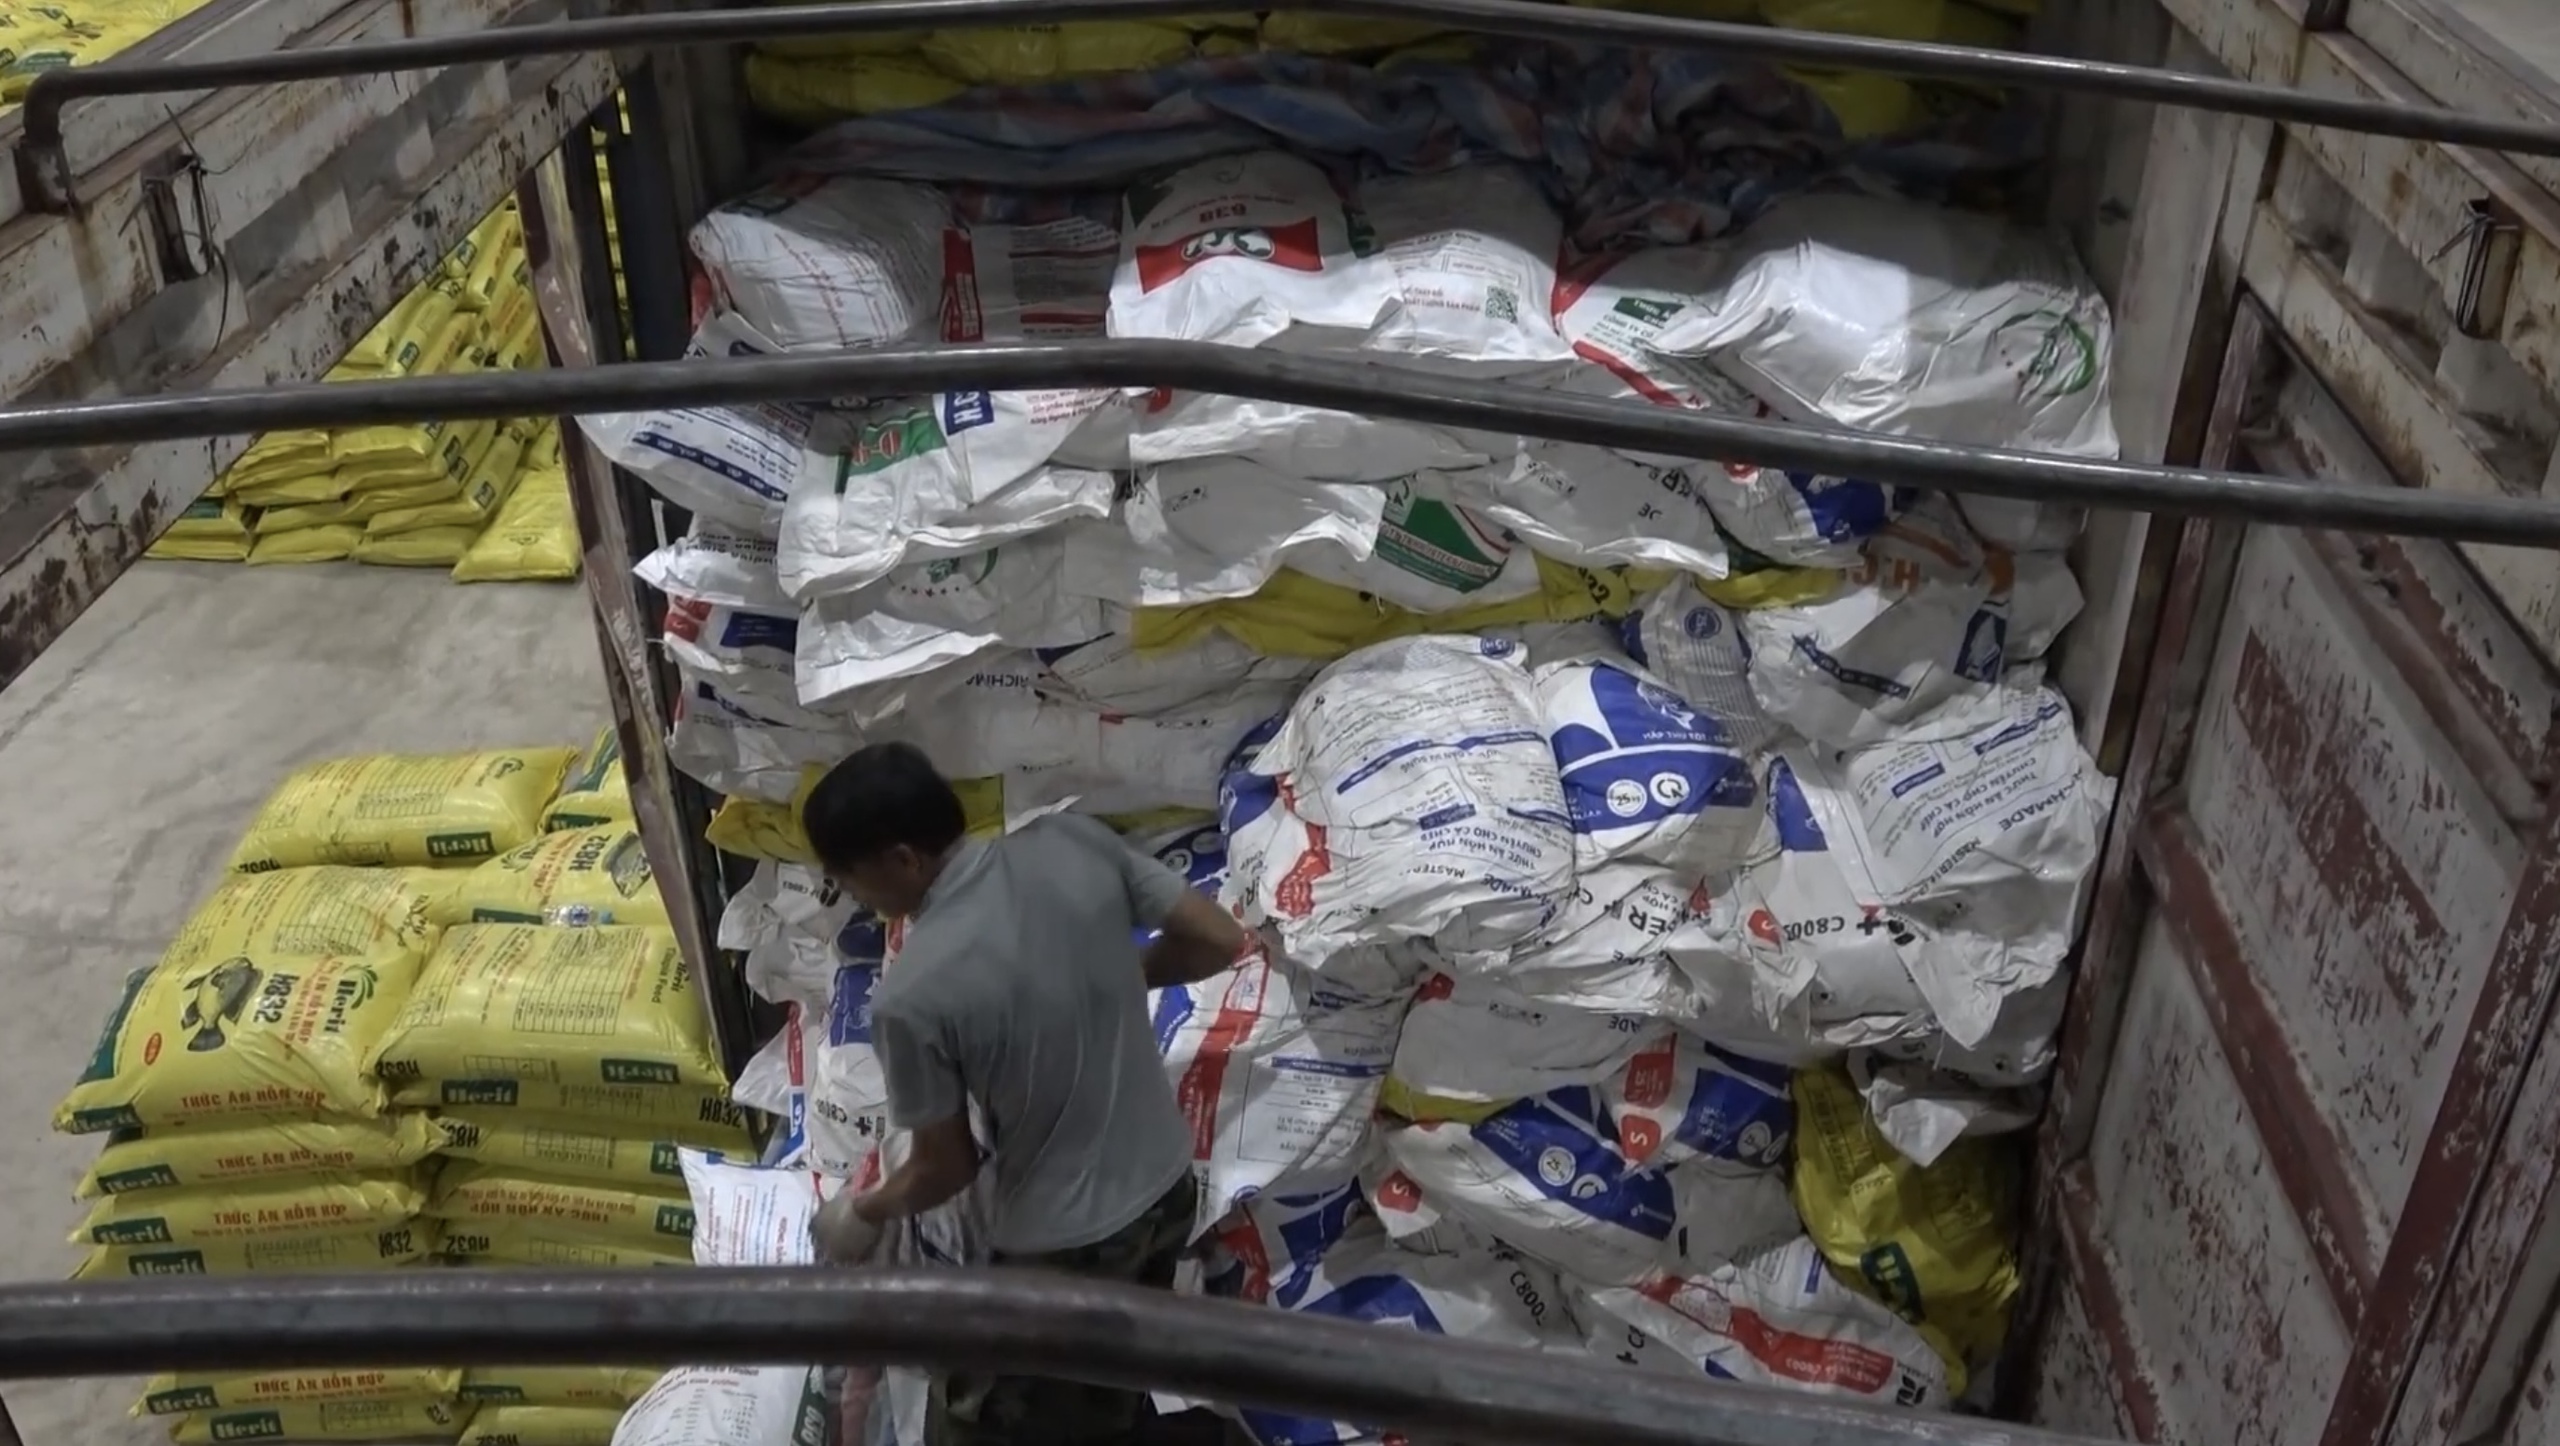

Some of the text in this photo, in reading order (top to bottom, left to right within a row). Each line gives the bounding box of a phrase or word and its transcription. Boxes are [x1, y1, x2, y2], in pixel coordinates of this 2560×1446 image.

[252, 972, 301, 1025] H832
[700, 1098, 742, 1128] H832
[440, 1125, 480, 1148] H83
